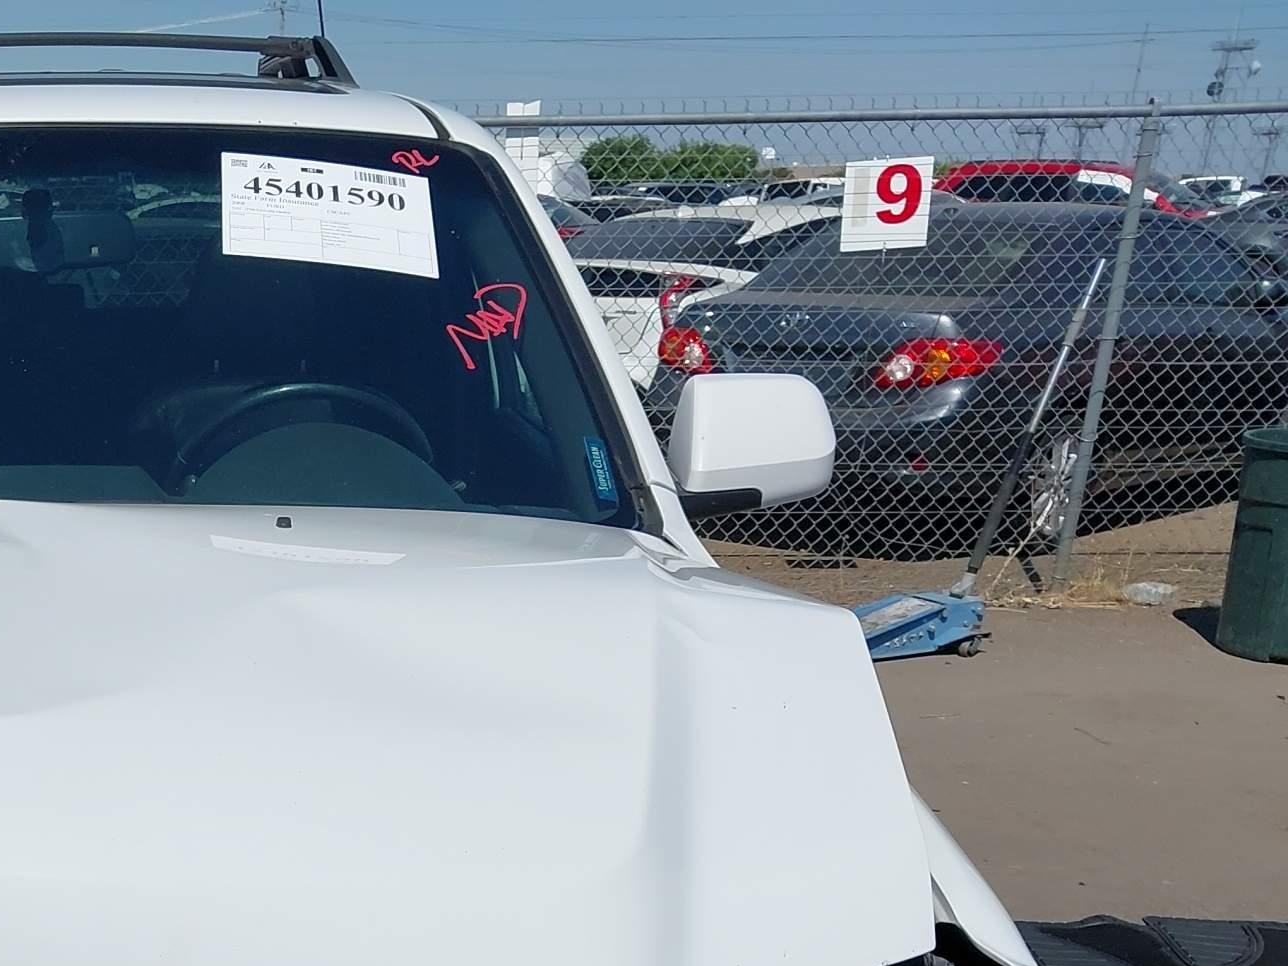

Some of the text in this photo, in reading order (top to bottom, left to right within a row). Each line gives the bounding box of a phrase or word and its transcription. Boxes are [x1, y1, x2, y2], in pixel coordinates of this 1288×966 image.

[231, 193, 252, 201] State
[279, 197, 319, 207] Insurance
[243, 176, 406, 212] 45401590
[876, 164, 923, 225] 9
